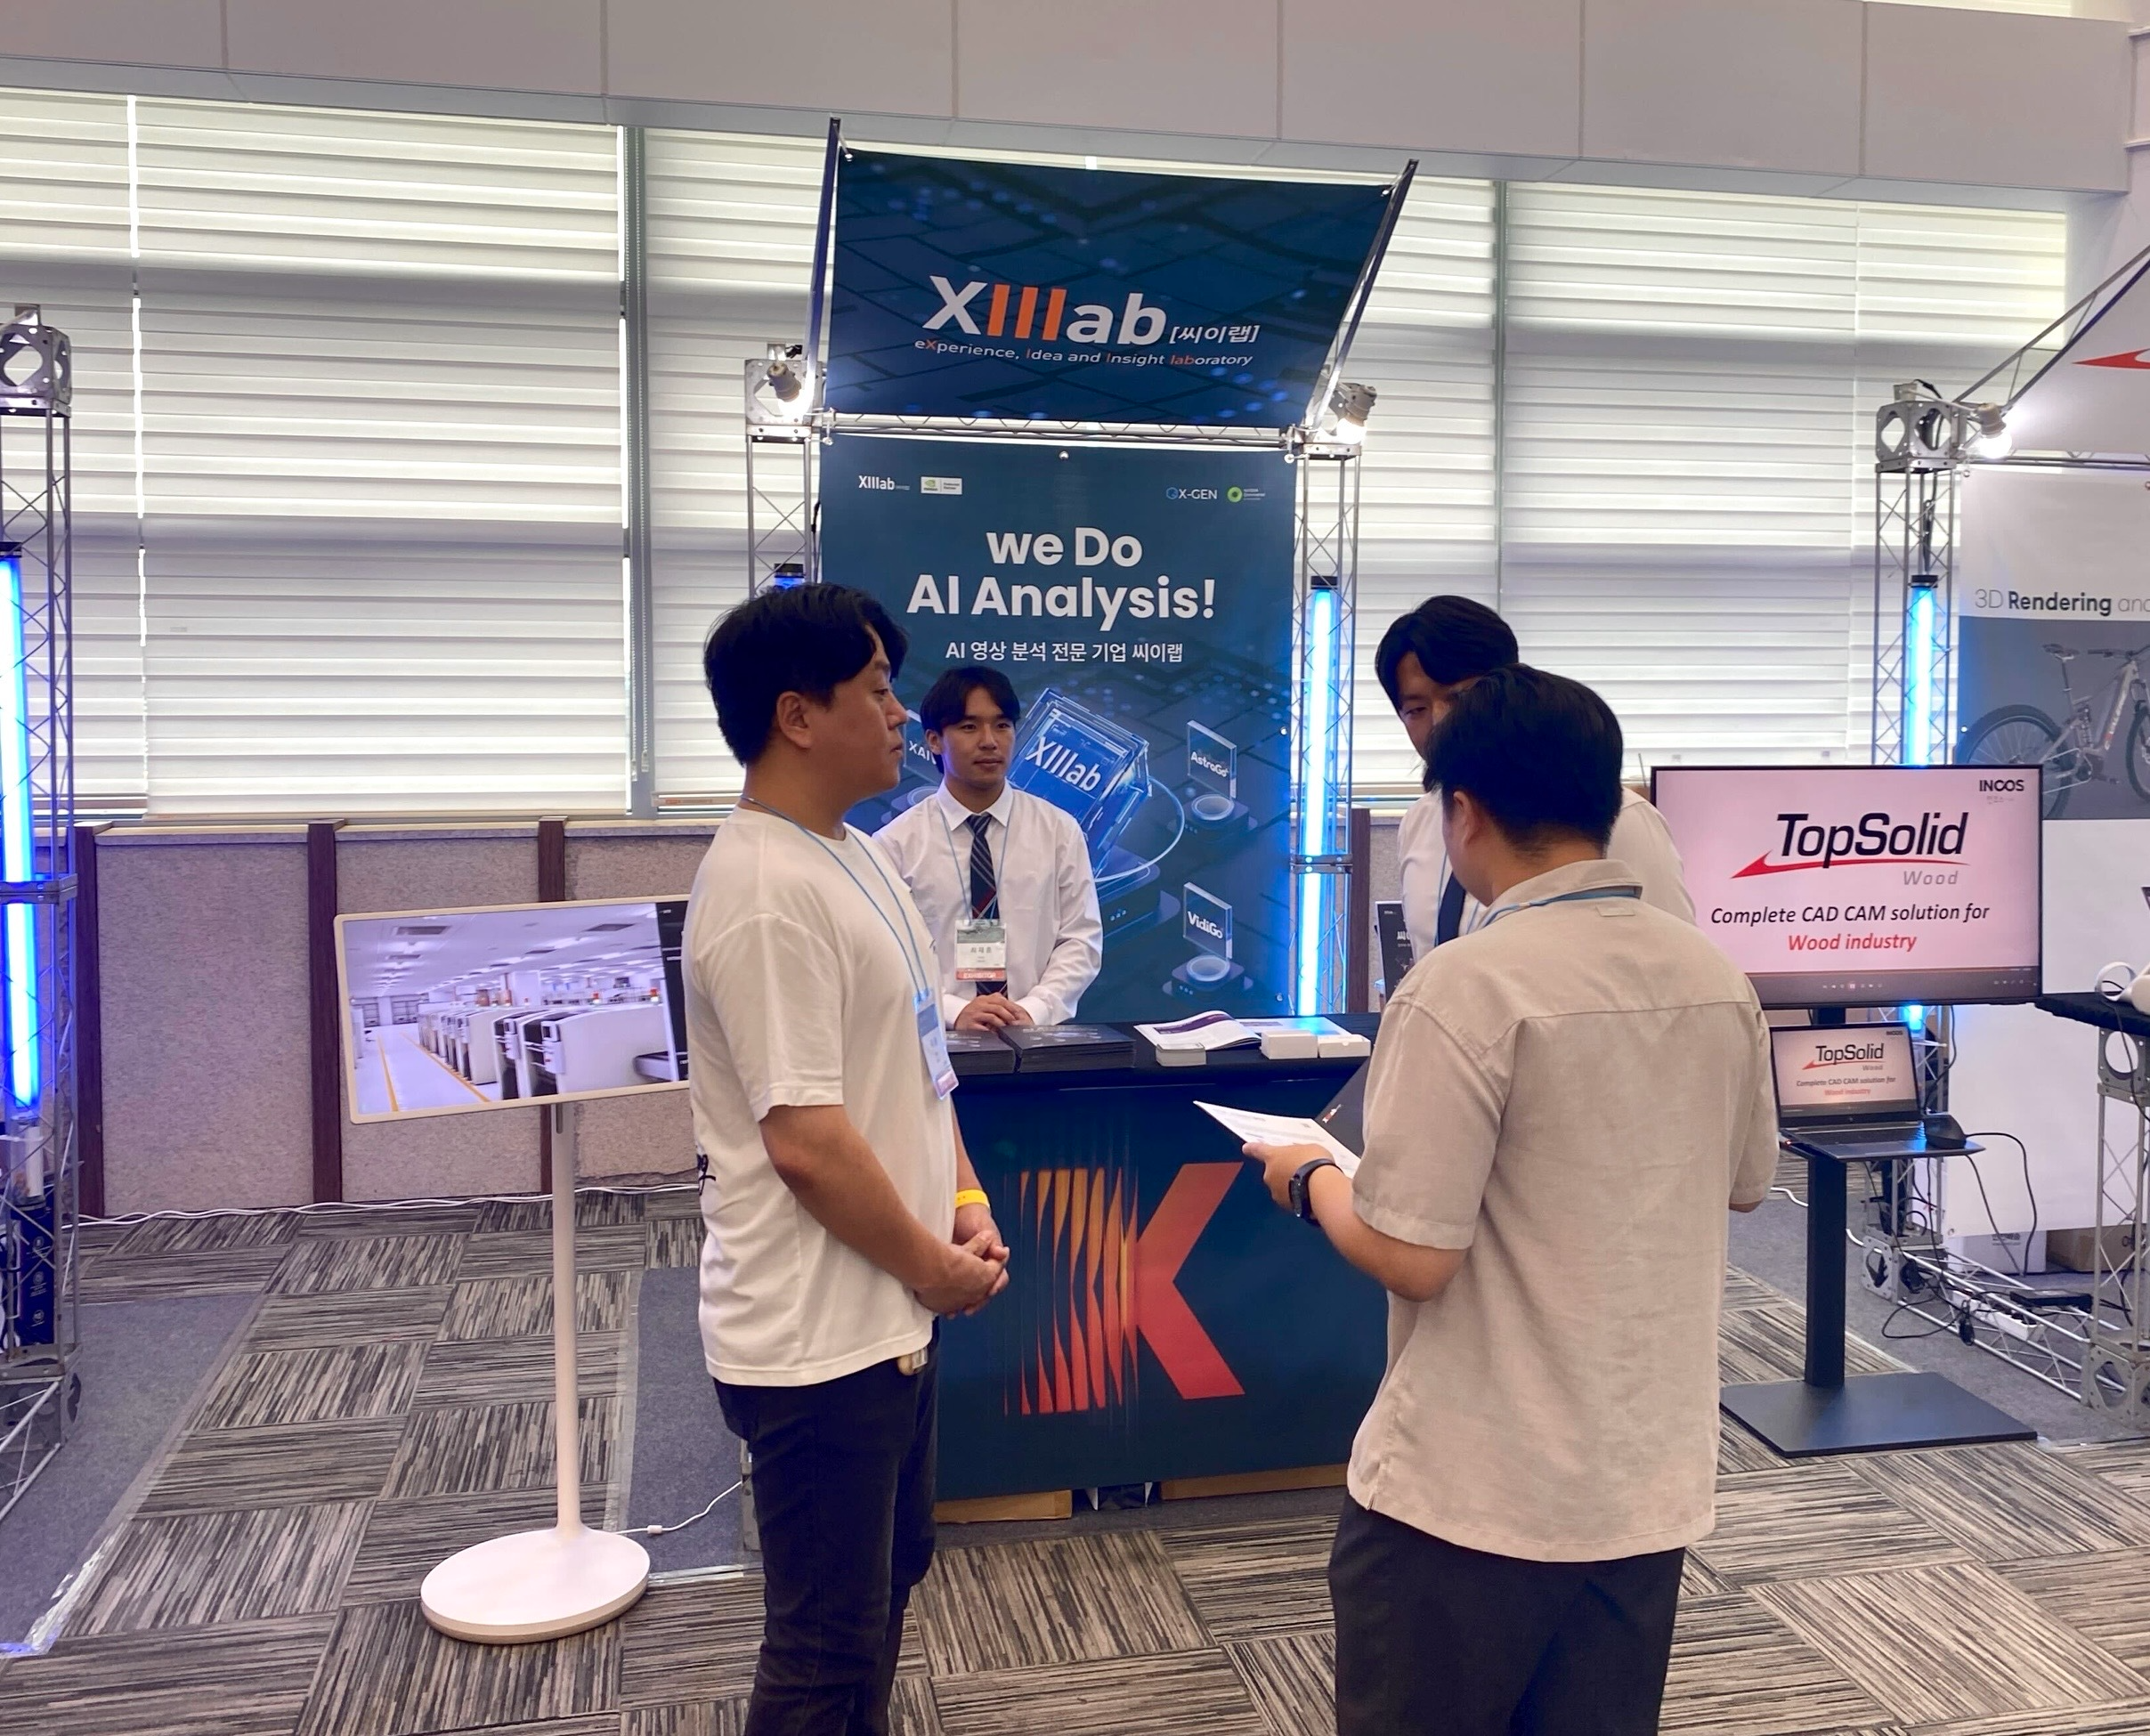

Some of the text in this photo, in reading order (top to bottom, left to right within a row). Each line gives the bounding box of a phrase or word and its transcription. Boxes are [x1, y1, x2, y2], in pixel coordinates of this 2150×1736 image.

[1169, 324, 1260, 345] [씨이랩]
[914, 338, 1253, 367] eXperience, Idea and Insight laboratory
[1178, 489, 1218, 499] X-GEN
[986, 527, 1143, 567] we Do
[906, 573, 1216, 631] AI Analysis!
[1975, 588, 2003, 609] 3D
[2008, 590, 2112, 616] Rendering
[945, 641, 1183, 662] AI 영상 분석 전문 기업 씨이랩
[1776, 811, 1969, 869] TopSolid
[1903, 870, 1959, 886] Wood
[1710, 902, 1991, 928] Complete CAD CAM solution for
[1788, 932, 1917, 953] Wood industry
[1815, 1042, 1885, 1065] TopSolid
